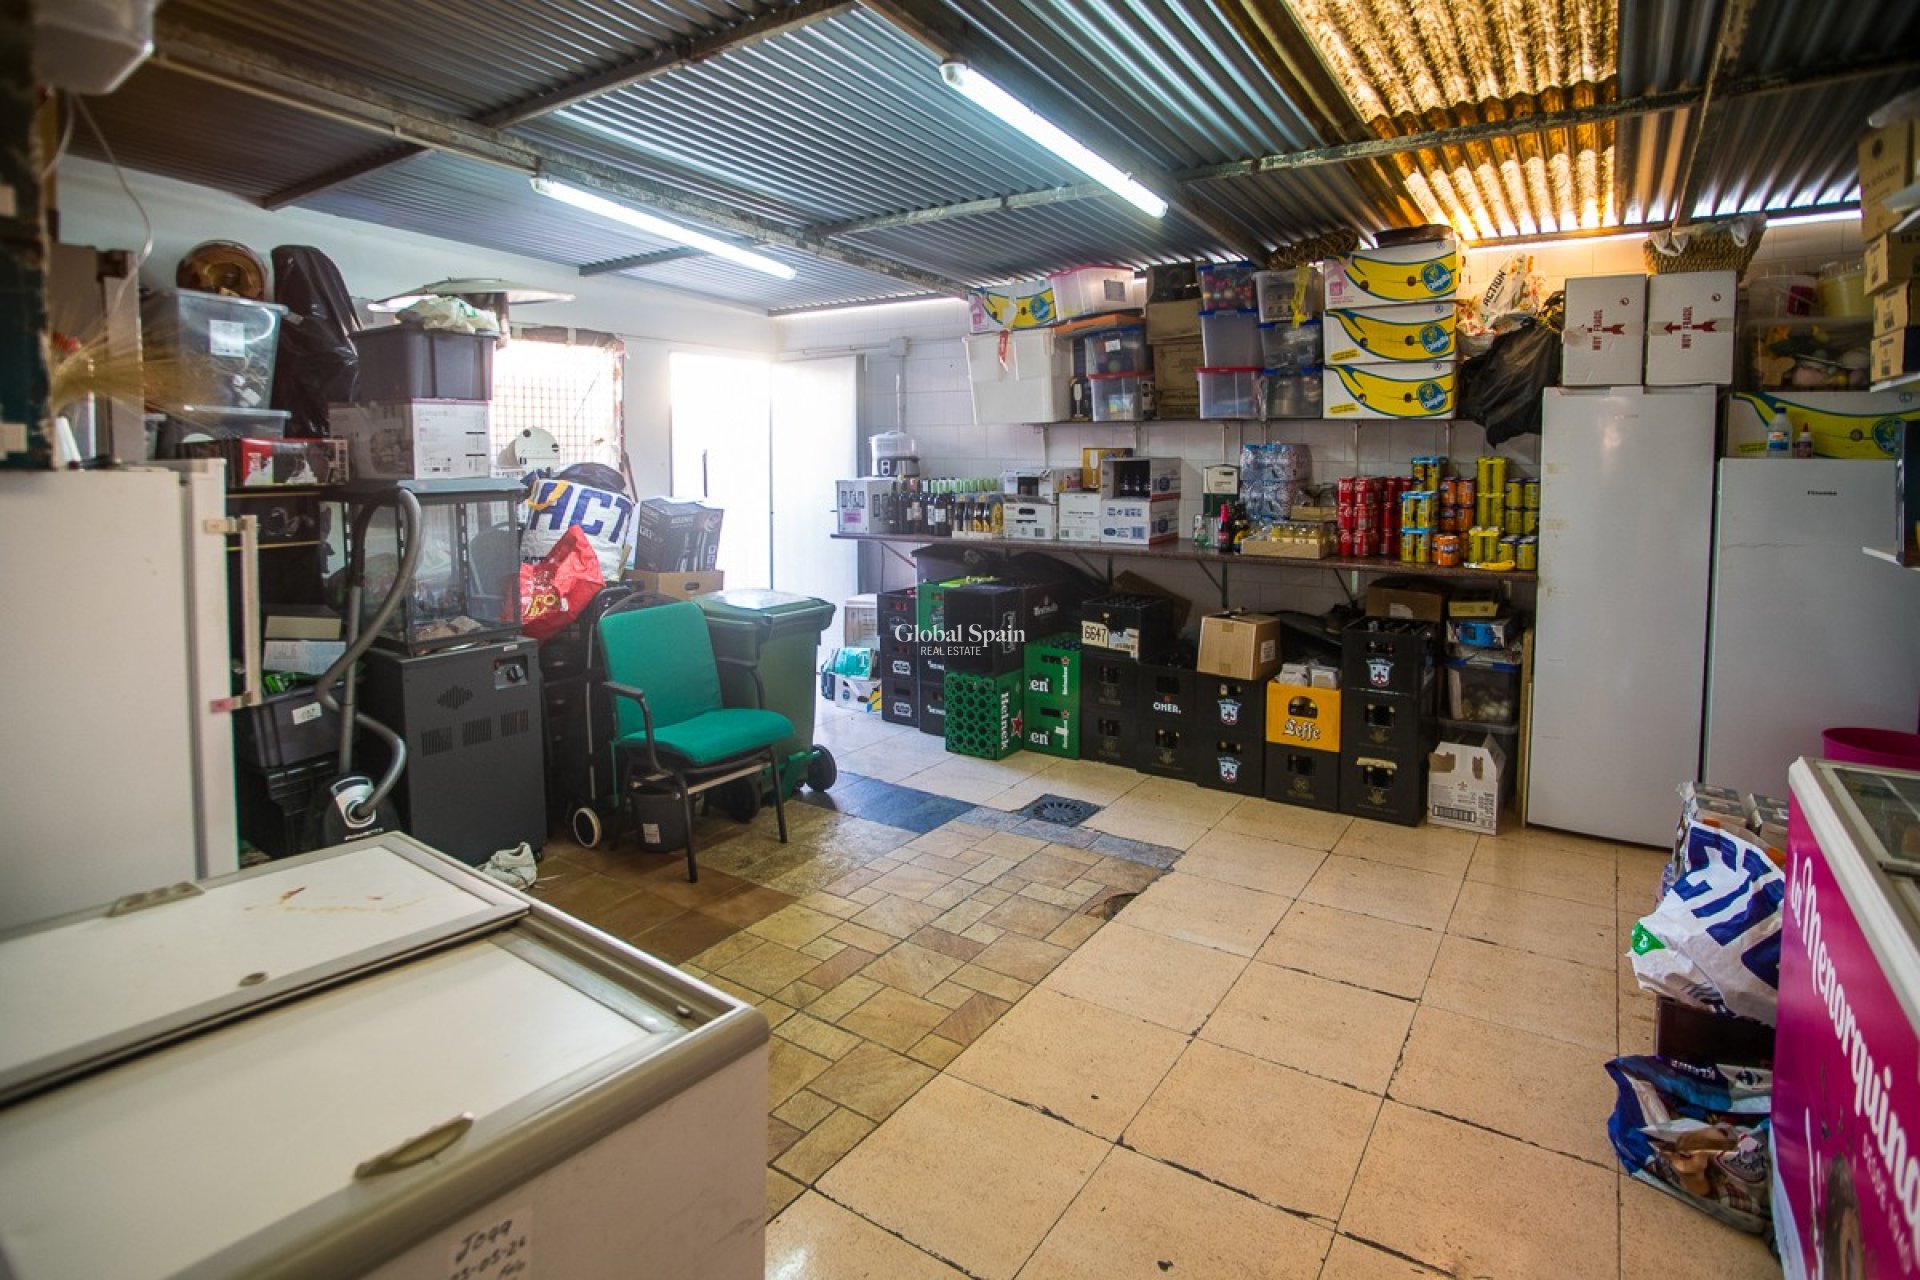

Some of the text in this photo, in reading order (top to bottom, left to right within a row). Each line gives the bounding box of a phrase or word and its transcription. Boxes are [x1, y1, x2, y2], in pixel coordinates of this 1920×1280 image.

[1482, 269, 1507, 307] ACTION
[1084, 625, 1107, 643] 6647
[1282, 718, 1321, 742] Leffe
